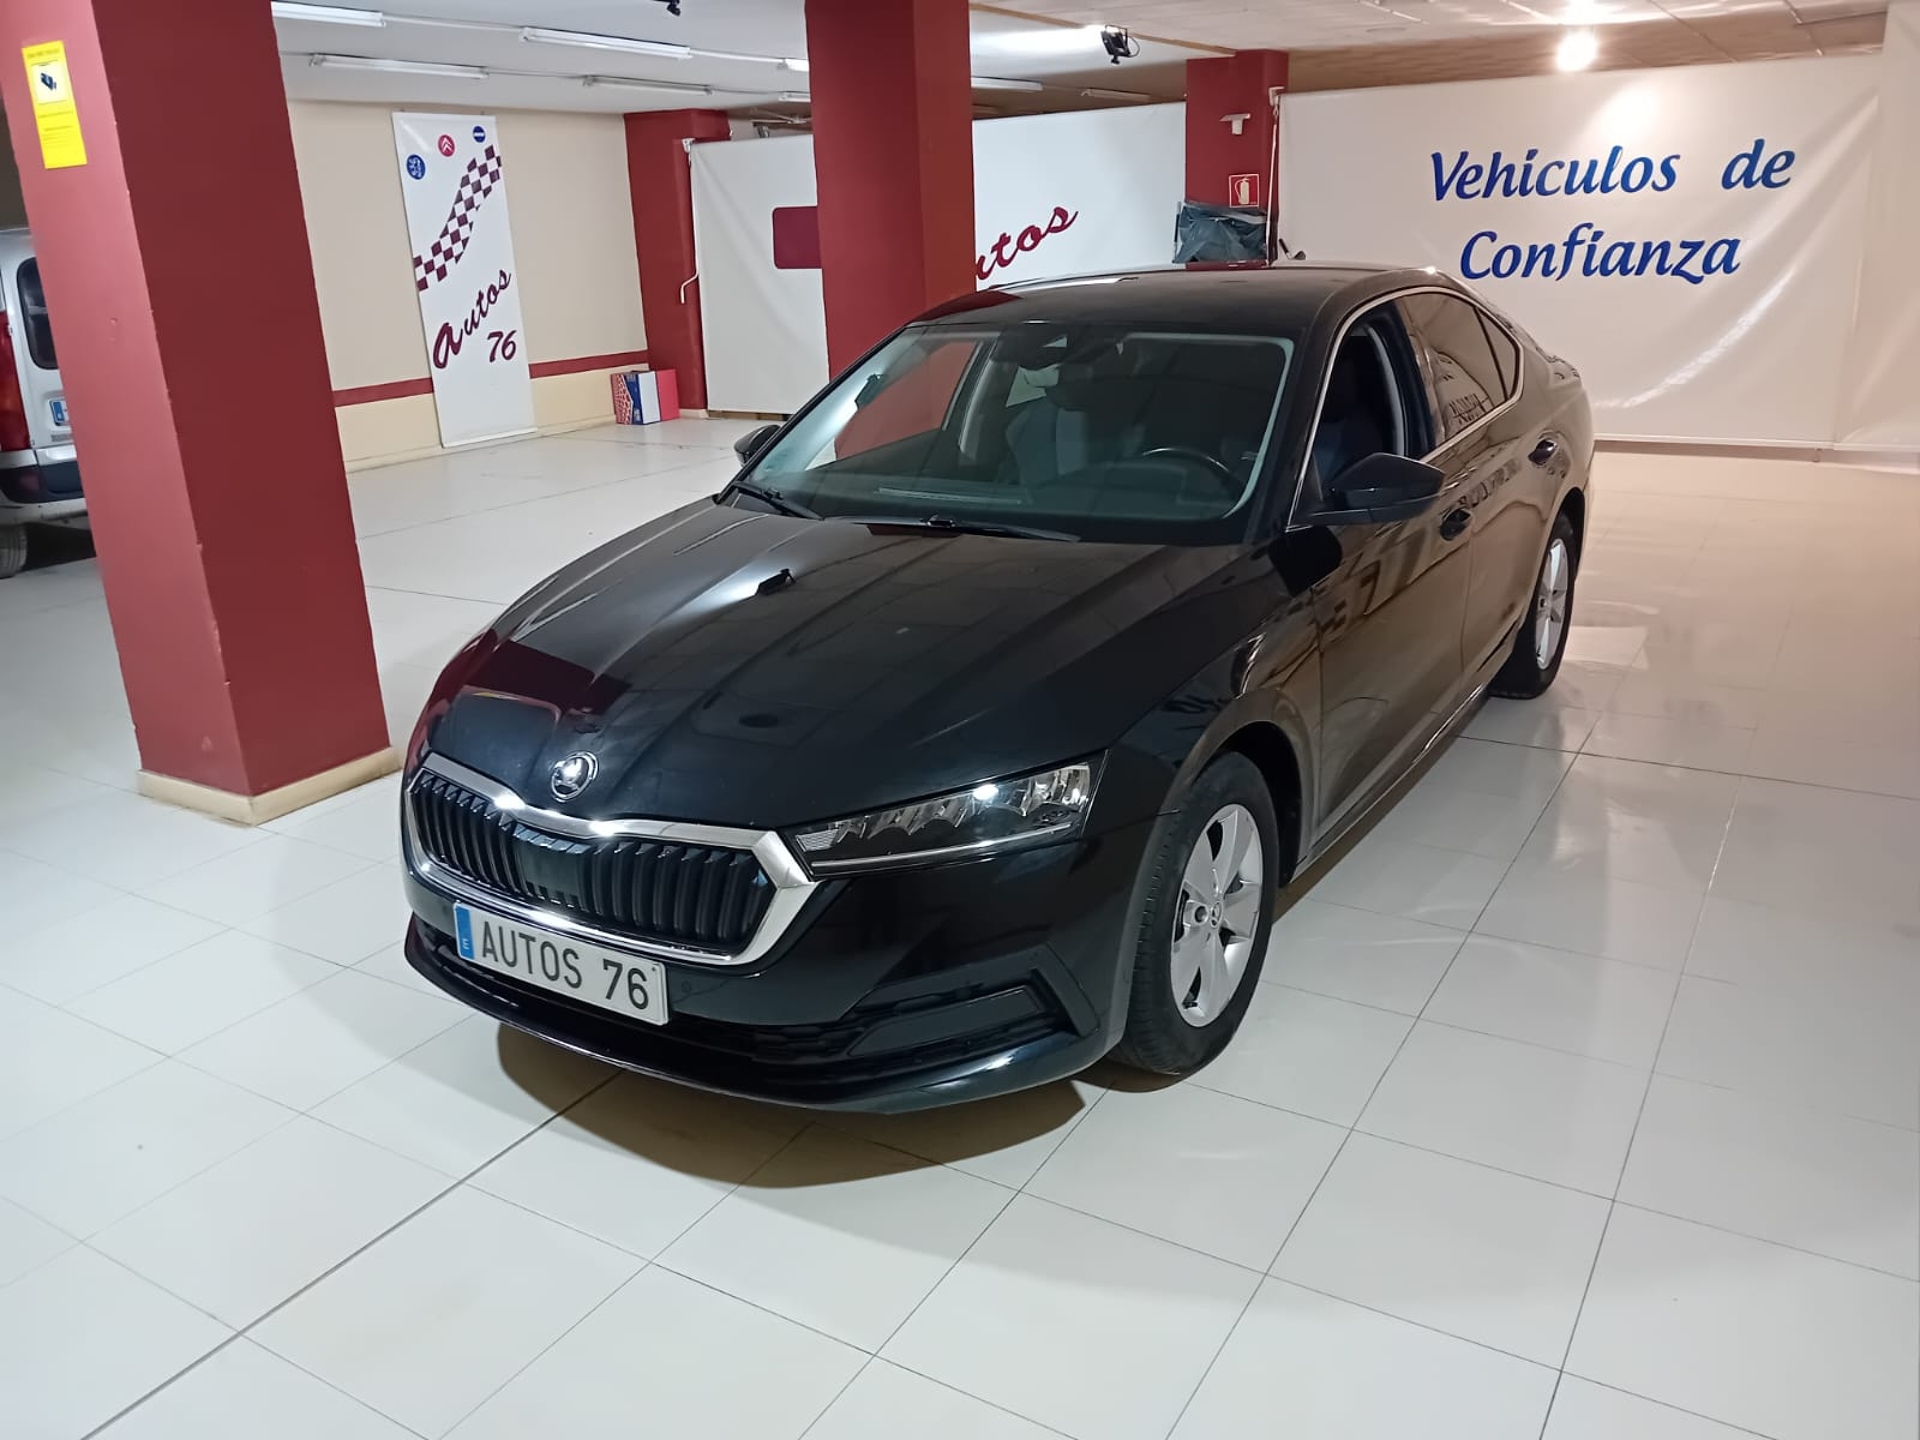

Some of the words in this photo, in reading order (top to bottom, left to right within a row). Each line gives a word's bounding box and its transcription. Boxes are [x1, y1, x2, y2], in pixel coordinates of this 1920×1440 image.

[1720, 138, 1796, 190] de
[1460, 222, 1741, 284] Confianza
[487, 330, 517, 363] 76
[462, 938, 470, 950] E
[482, 921, 582, 989] AUTOS
[603, 958, 649, 1010] 76
